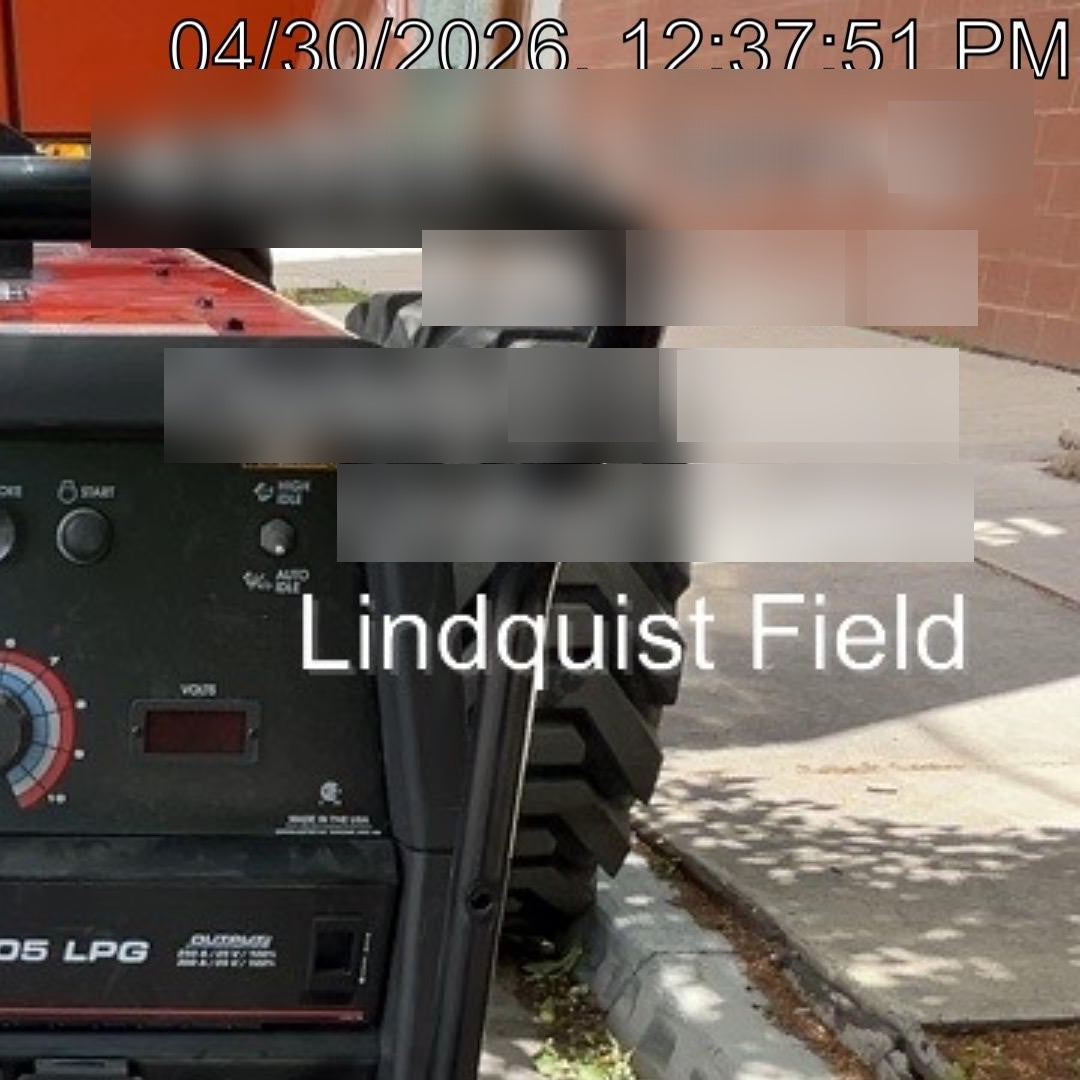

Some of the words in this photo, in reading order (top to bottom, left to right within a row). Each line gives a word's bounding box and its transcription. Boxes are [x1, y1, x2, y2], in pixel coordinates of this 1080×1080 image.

[80, 485, 116, 499] START
[275, 568, 310, 581] AUTO
[62, 940, 151, 964] LPG
